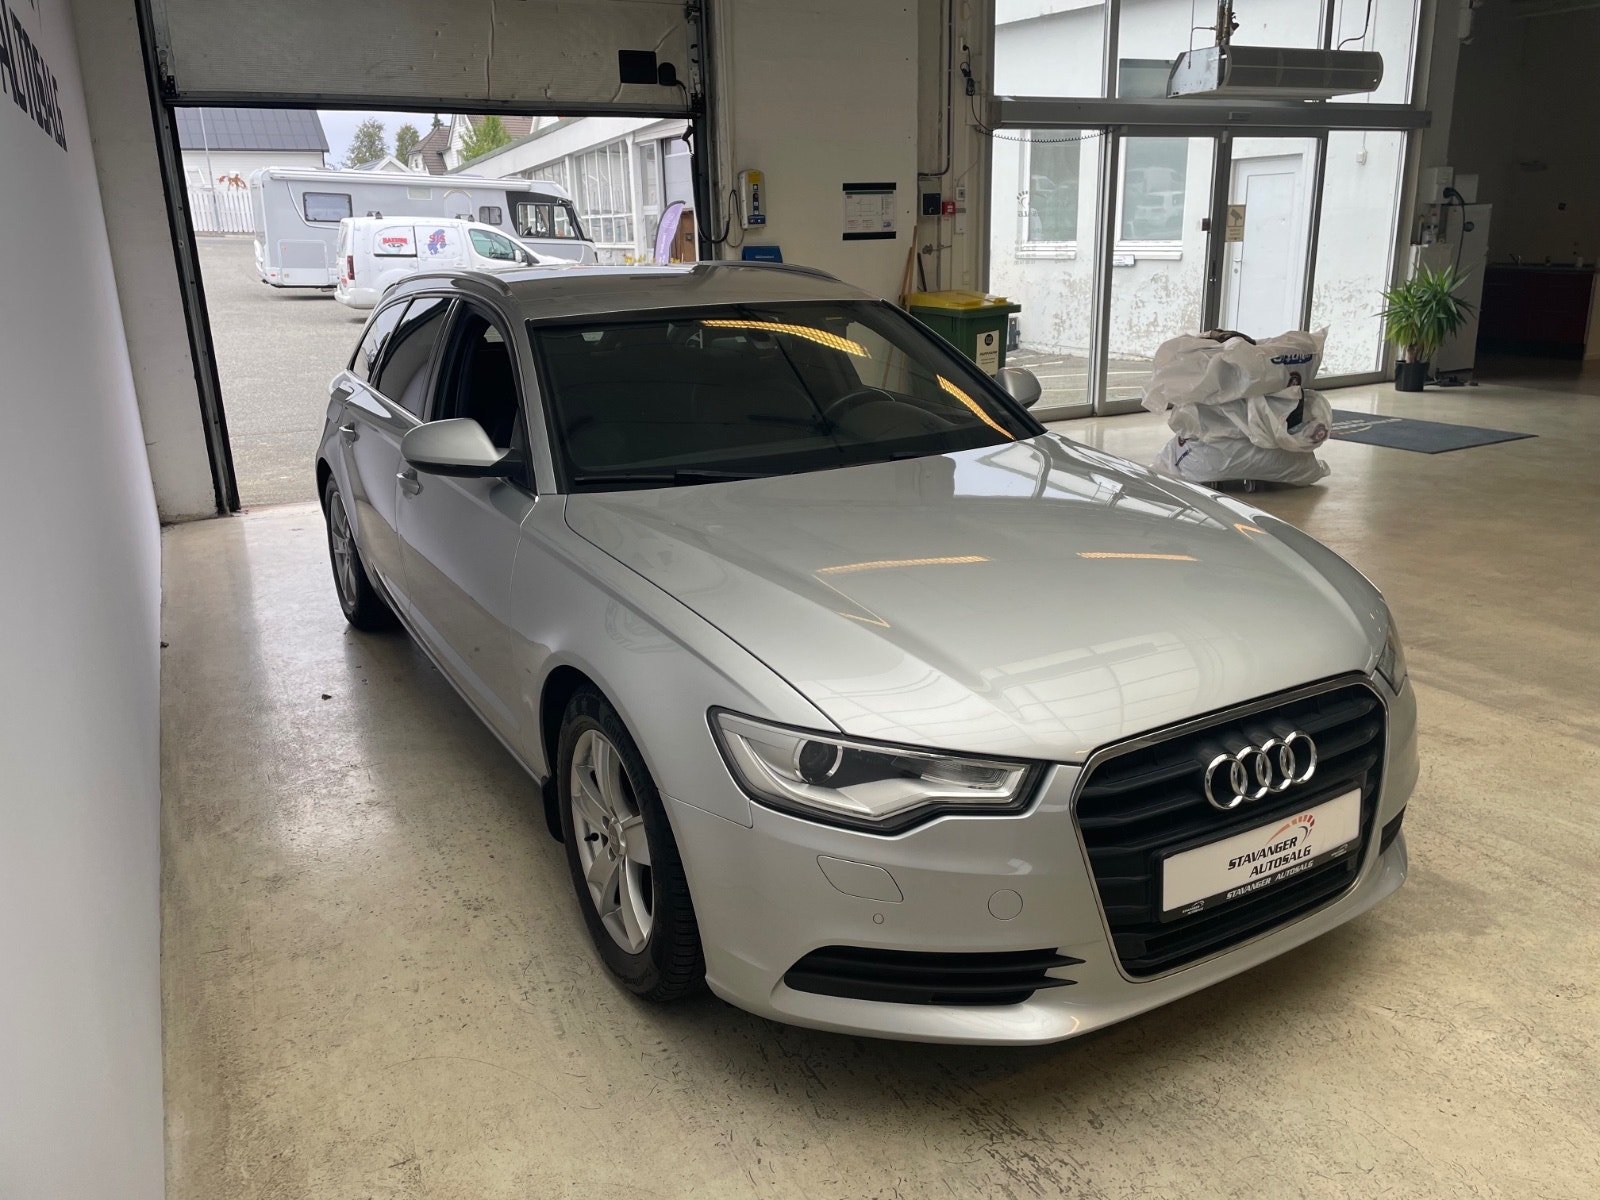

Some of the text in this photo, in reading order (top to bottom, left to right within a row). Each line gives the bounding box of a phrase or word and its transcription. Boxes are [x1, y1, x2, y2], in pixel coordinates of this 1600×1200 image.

[1227, 836, 1298, 871] STAVANGER
[1249, 845, 1312, 878] AUTOSALG
[1226, 860, 1314, 900] STAVANGER AUTOSALG
